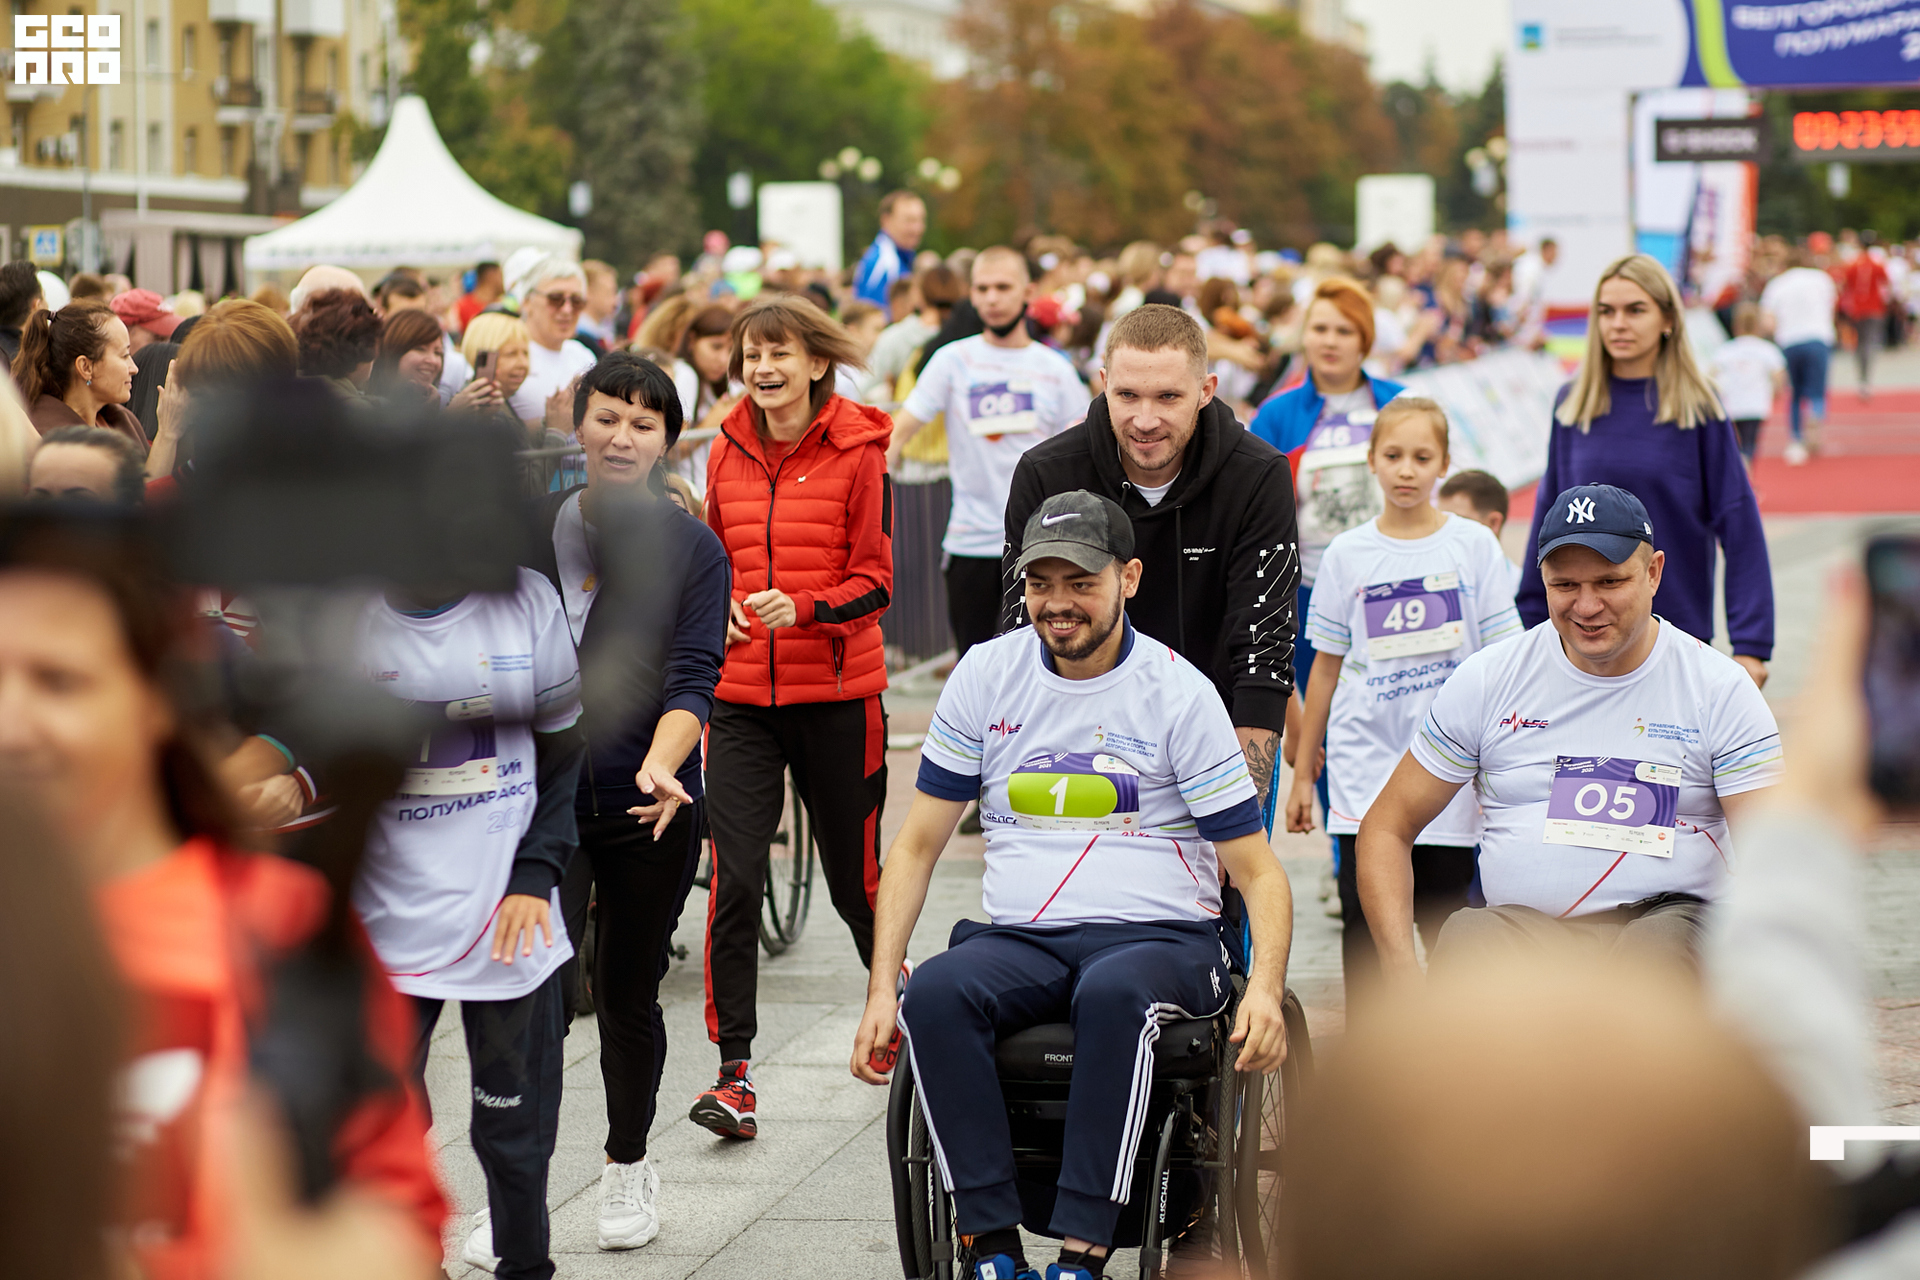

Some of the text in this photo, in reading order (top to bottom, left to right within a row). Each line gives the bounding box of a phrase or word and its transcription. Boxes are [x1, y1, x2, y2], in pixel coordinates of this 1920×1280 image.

[1566, 496, 1596, 524] NY
[1382, 599, 1426, 631] 49
[1049, 776, 1069, 815] 1
[1573, 782, 1637, 820] 05
[1044, 1053, 1074, 1062] FRONT
